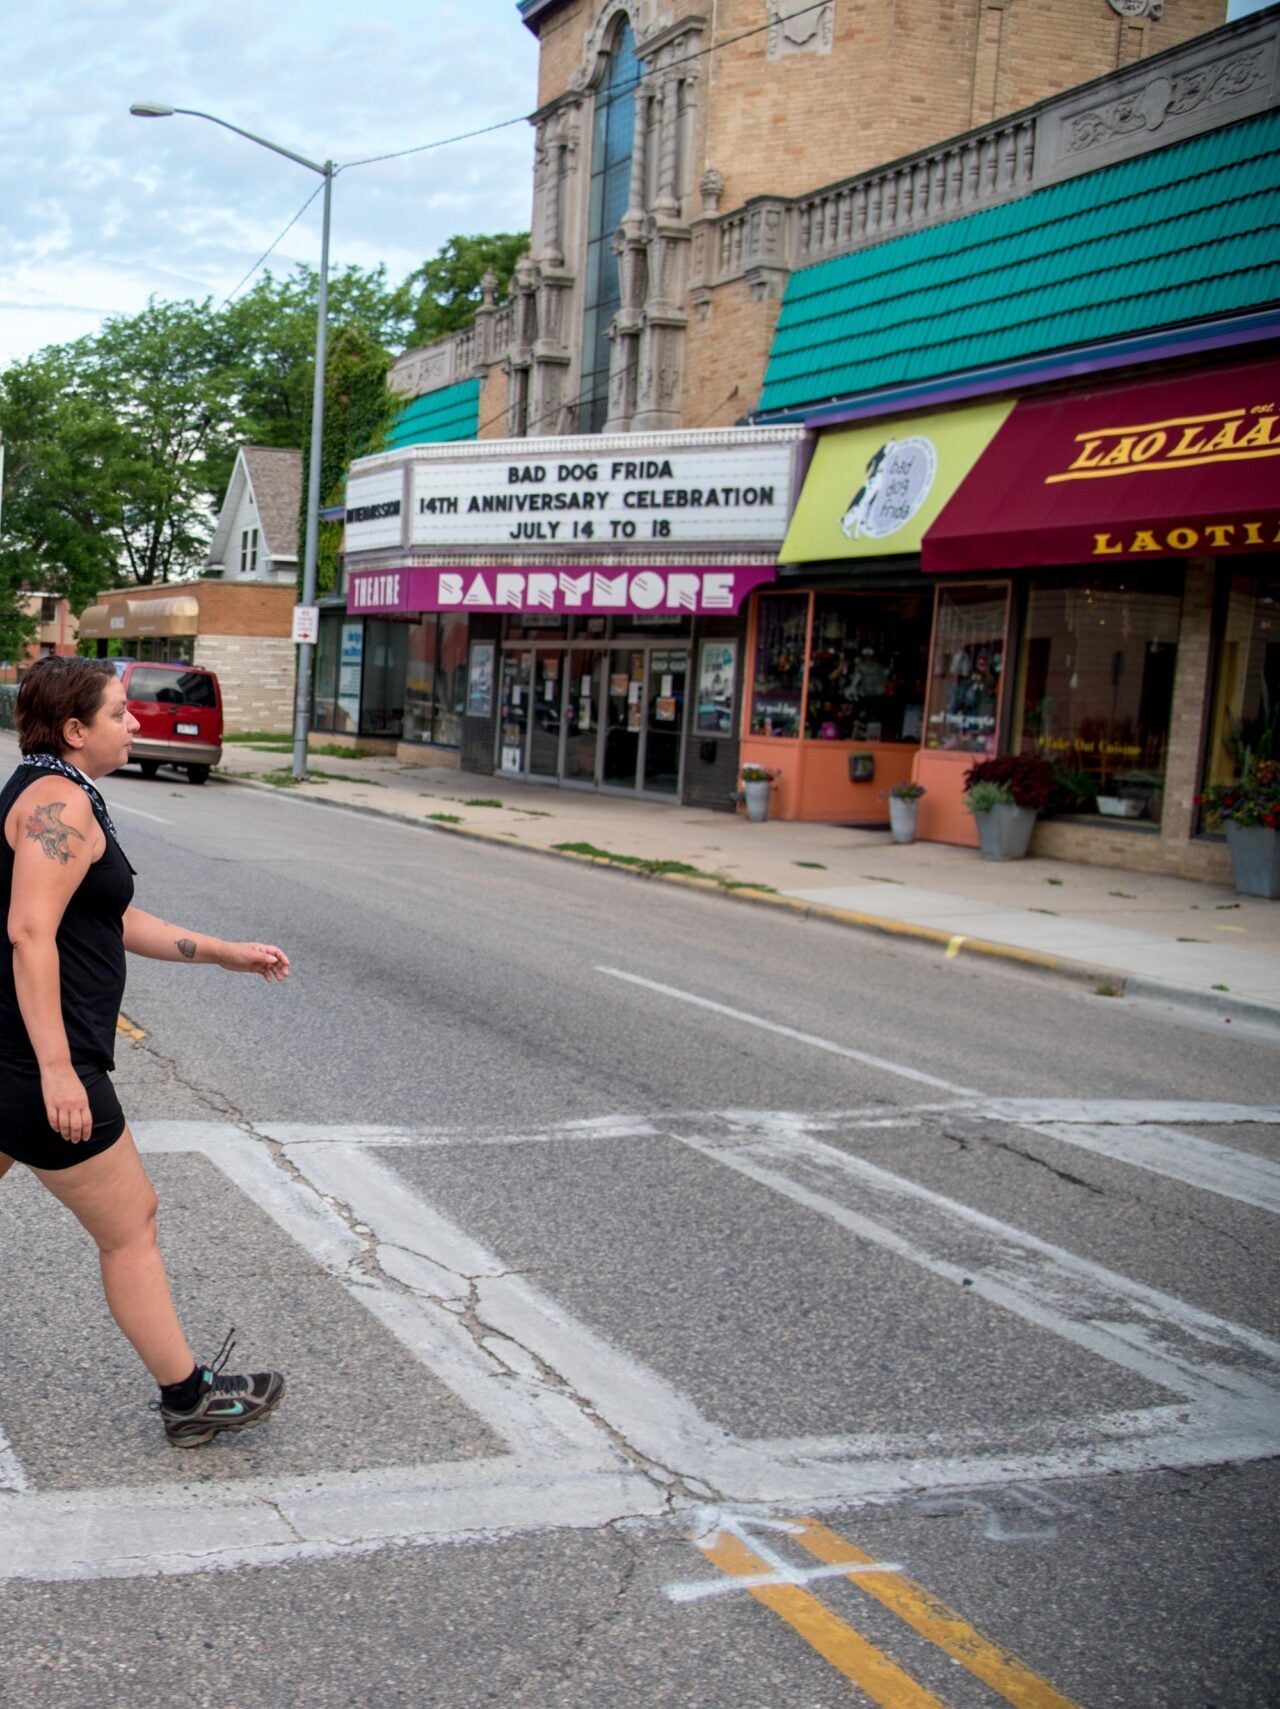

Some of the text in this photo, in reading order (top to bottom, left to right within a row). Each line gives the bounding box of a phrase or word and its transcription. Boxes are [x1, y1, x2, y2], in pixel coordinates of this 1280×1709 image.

[1068, 416, 1280, 469] LAO LAA
[508, 460, 673, 483] BAD DOG FRIDA
[419, 486, 774, 514] 14TH ANNIVERSARY CELEBRATION
[510, 520, 670, 539] JULY 14 TO 18
[354, 574, 400, 607] THEATRE
[438, 570, 735, 612] BARRYMORE
